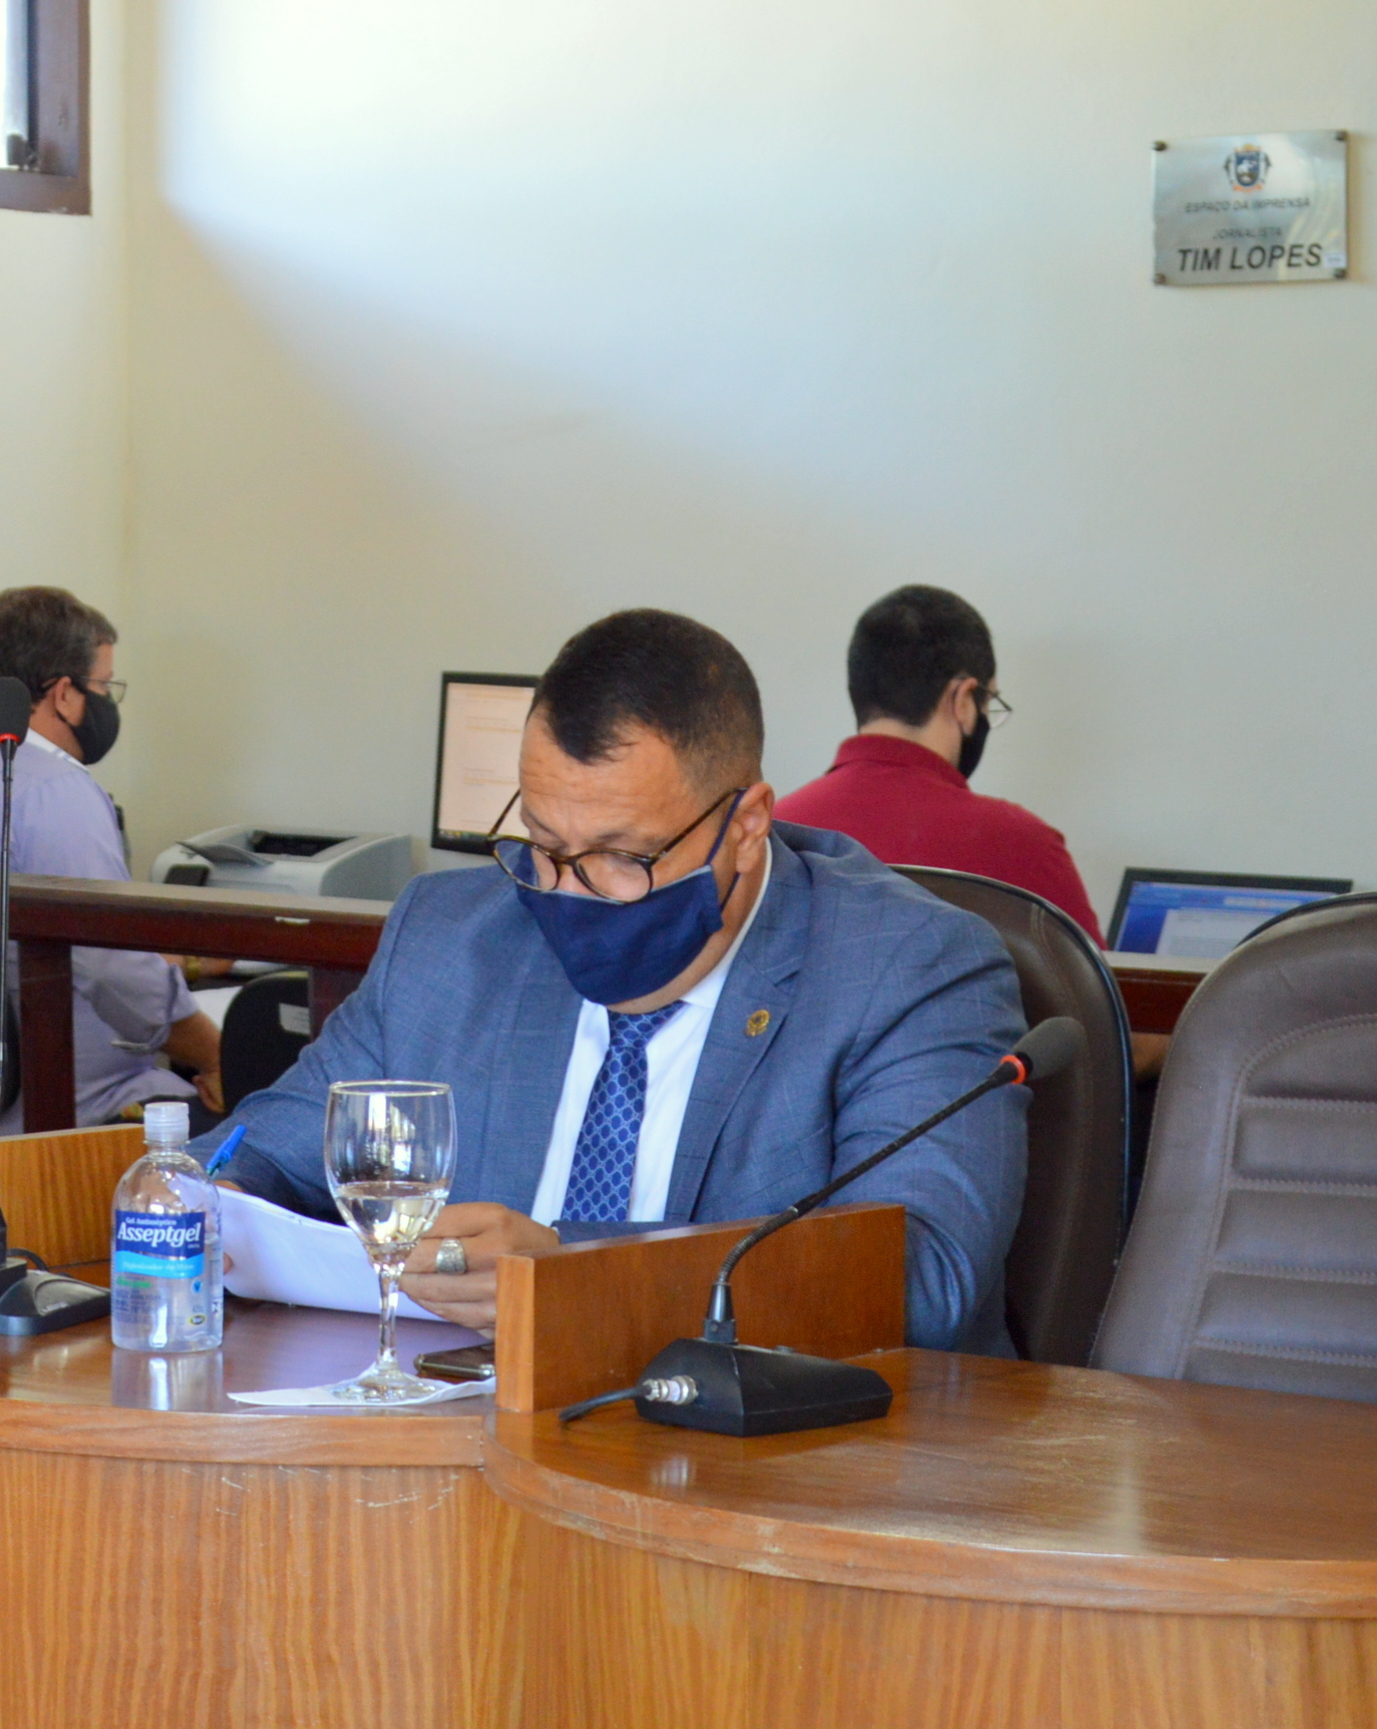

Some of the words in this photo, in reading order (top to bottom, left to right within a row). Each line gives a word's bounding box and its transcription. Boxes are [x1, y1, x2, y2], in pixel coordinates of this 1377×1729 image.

[1232, 200, 1249, 211] DA
[1177, 246, 1222, 271] TIM
[1229, 242, 1323, 270] LOPES
[117, 1221, 202, 1247] Asseptgel
